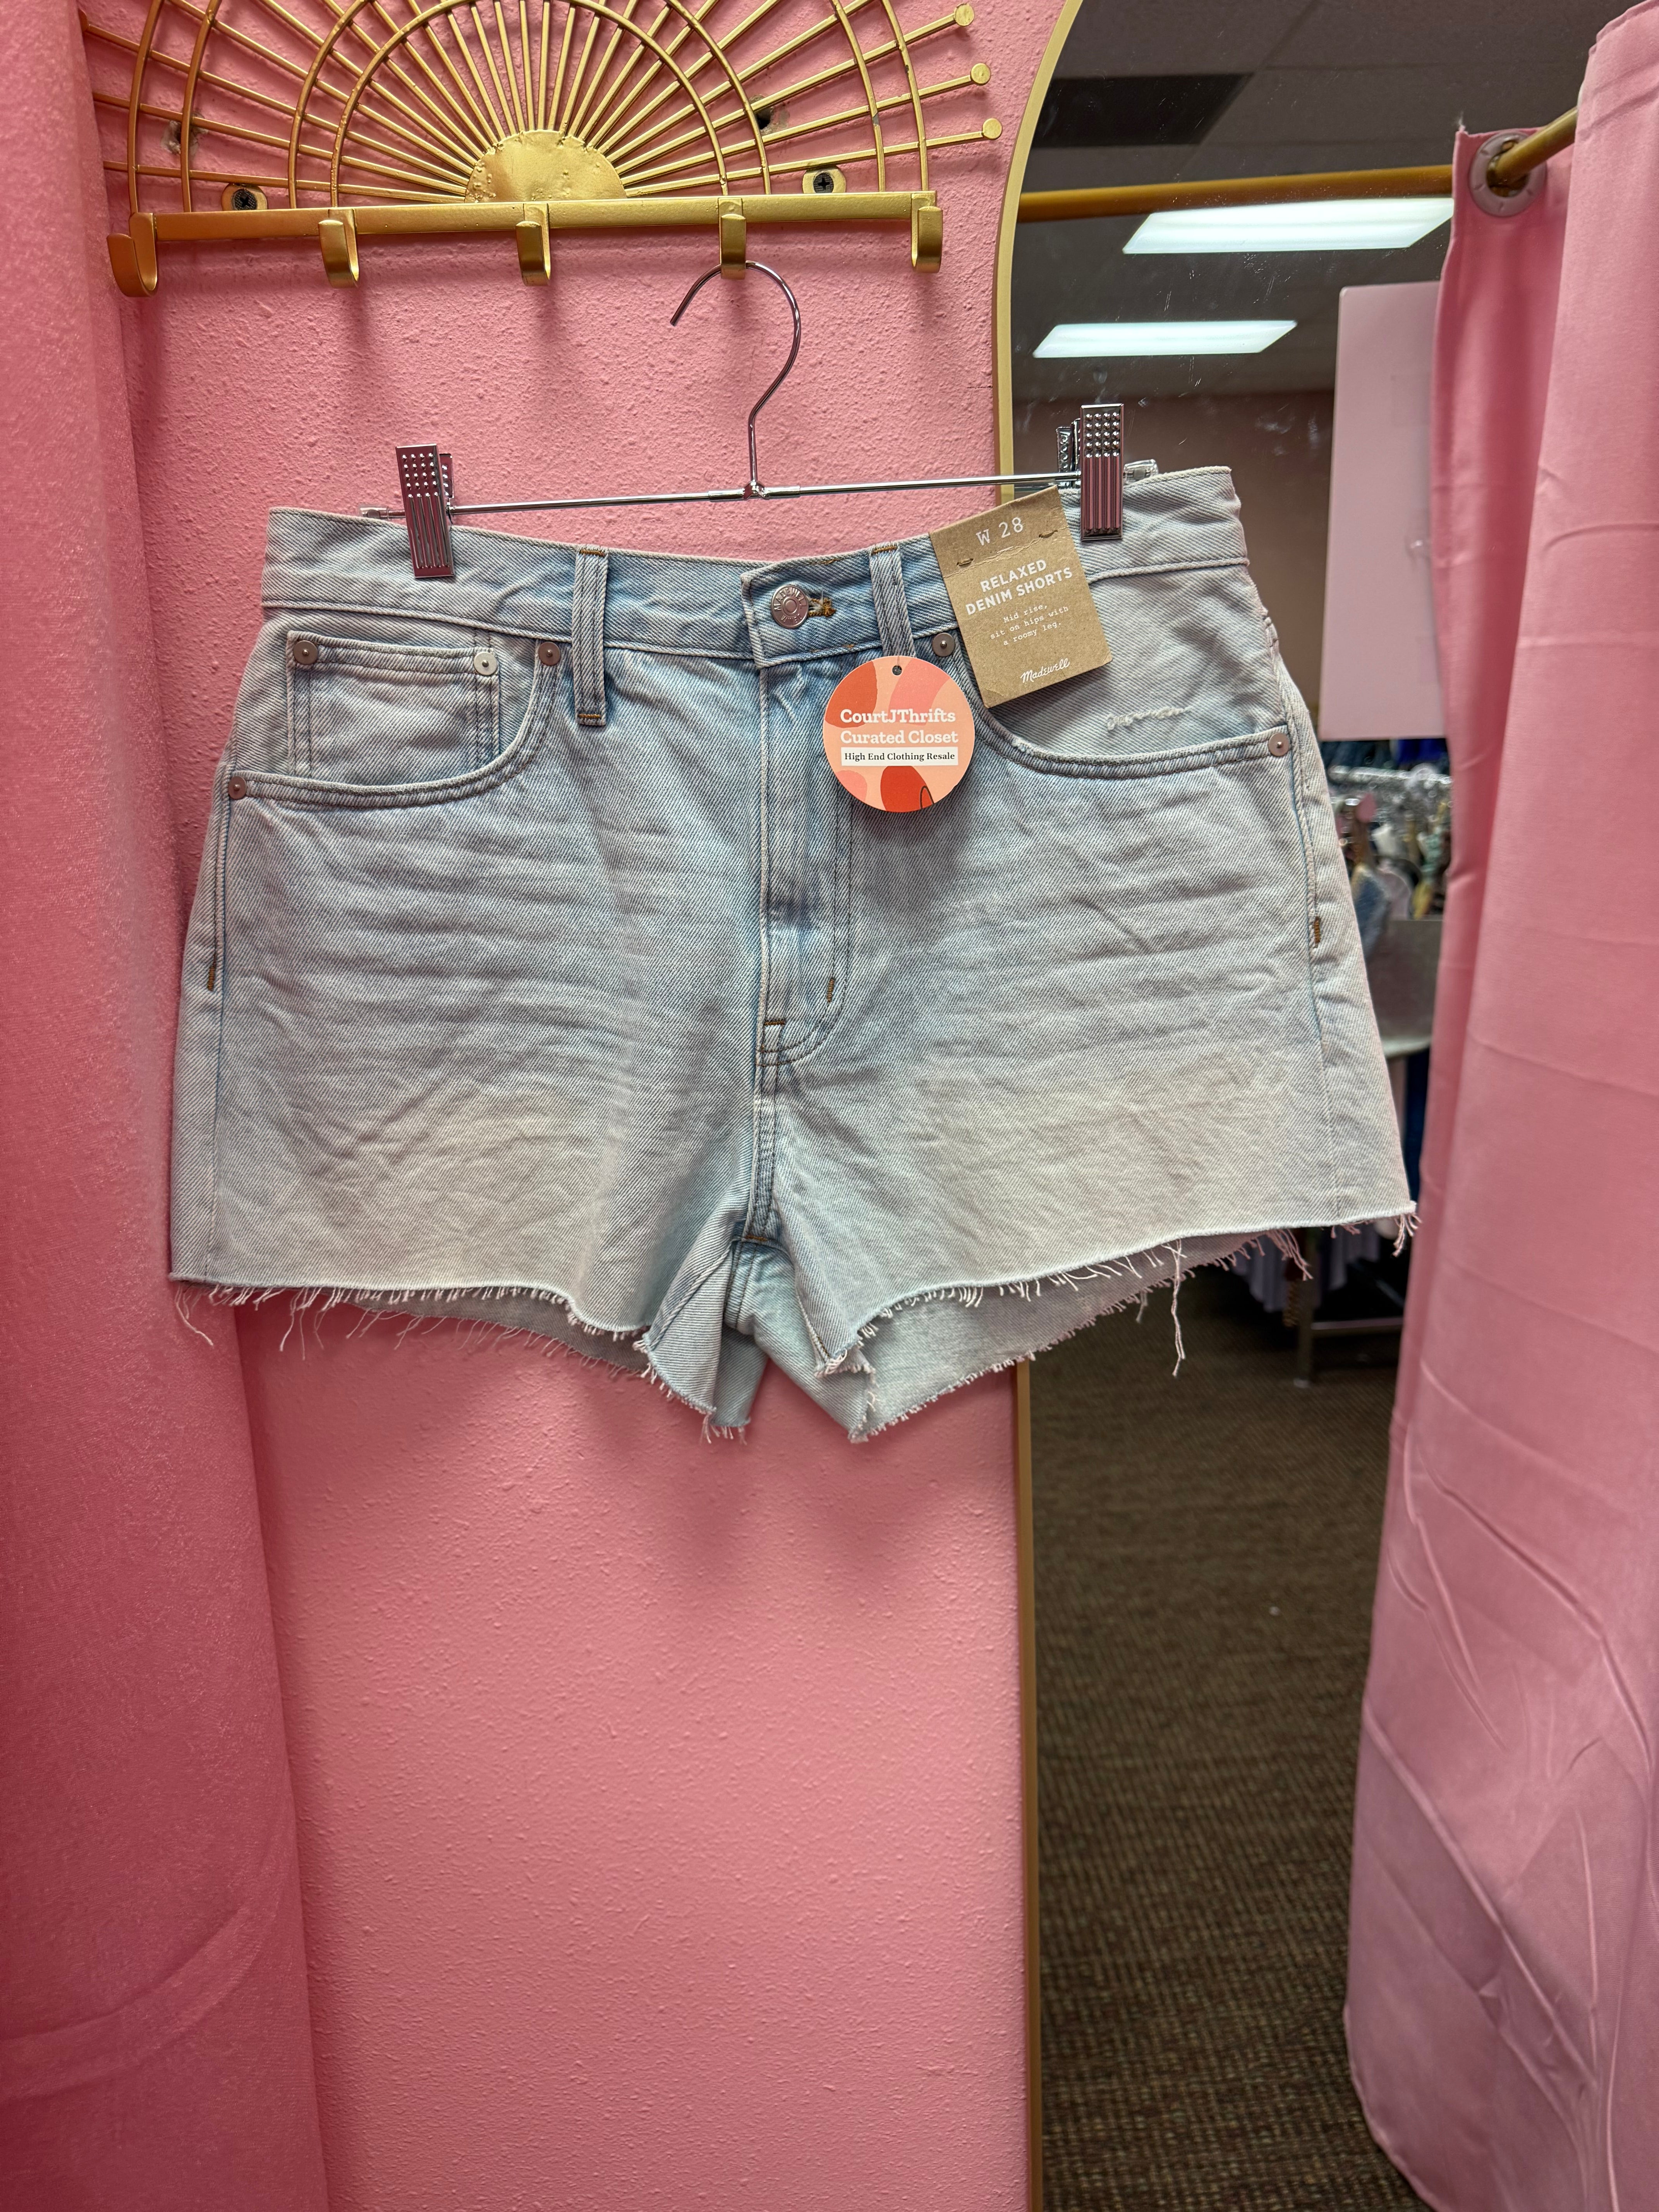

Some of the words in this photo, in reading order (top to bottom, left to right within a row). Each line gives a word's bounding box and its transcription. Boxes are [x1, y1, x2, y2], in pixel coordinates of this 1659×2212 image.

[975, 529, 990, 546] W
[998, 517, 1023, 538] 28
[980, 560, 1046, 592] RELAXED
[965, 589, 1013, 615] DENIM
[1016, 567, 1072, 596] SHORTS
[990, 630, 1005, 639] sit
[1010, 624, 1020, 632] on
[1024, 615, 1044, 627] hips
[1048, 606, 1069, 617] with
[1003, 612, 1019, 623] Mid
[1023, 604, 1047, 616] rise,
[1013, 629, 1037, 642] roomy
[1042, 622, 1061, 631] leg.
[1020, 658, 1070, 684] Madewell
[840, 708, 956, 723] CourtJThrifts
[840, 730, 906, 744] Curated
[908, 730, 959, 744] Closet
[845, 752, 866, 762] High
[887, 752, 924, 762] Clothing
